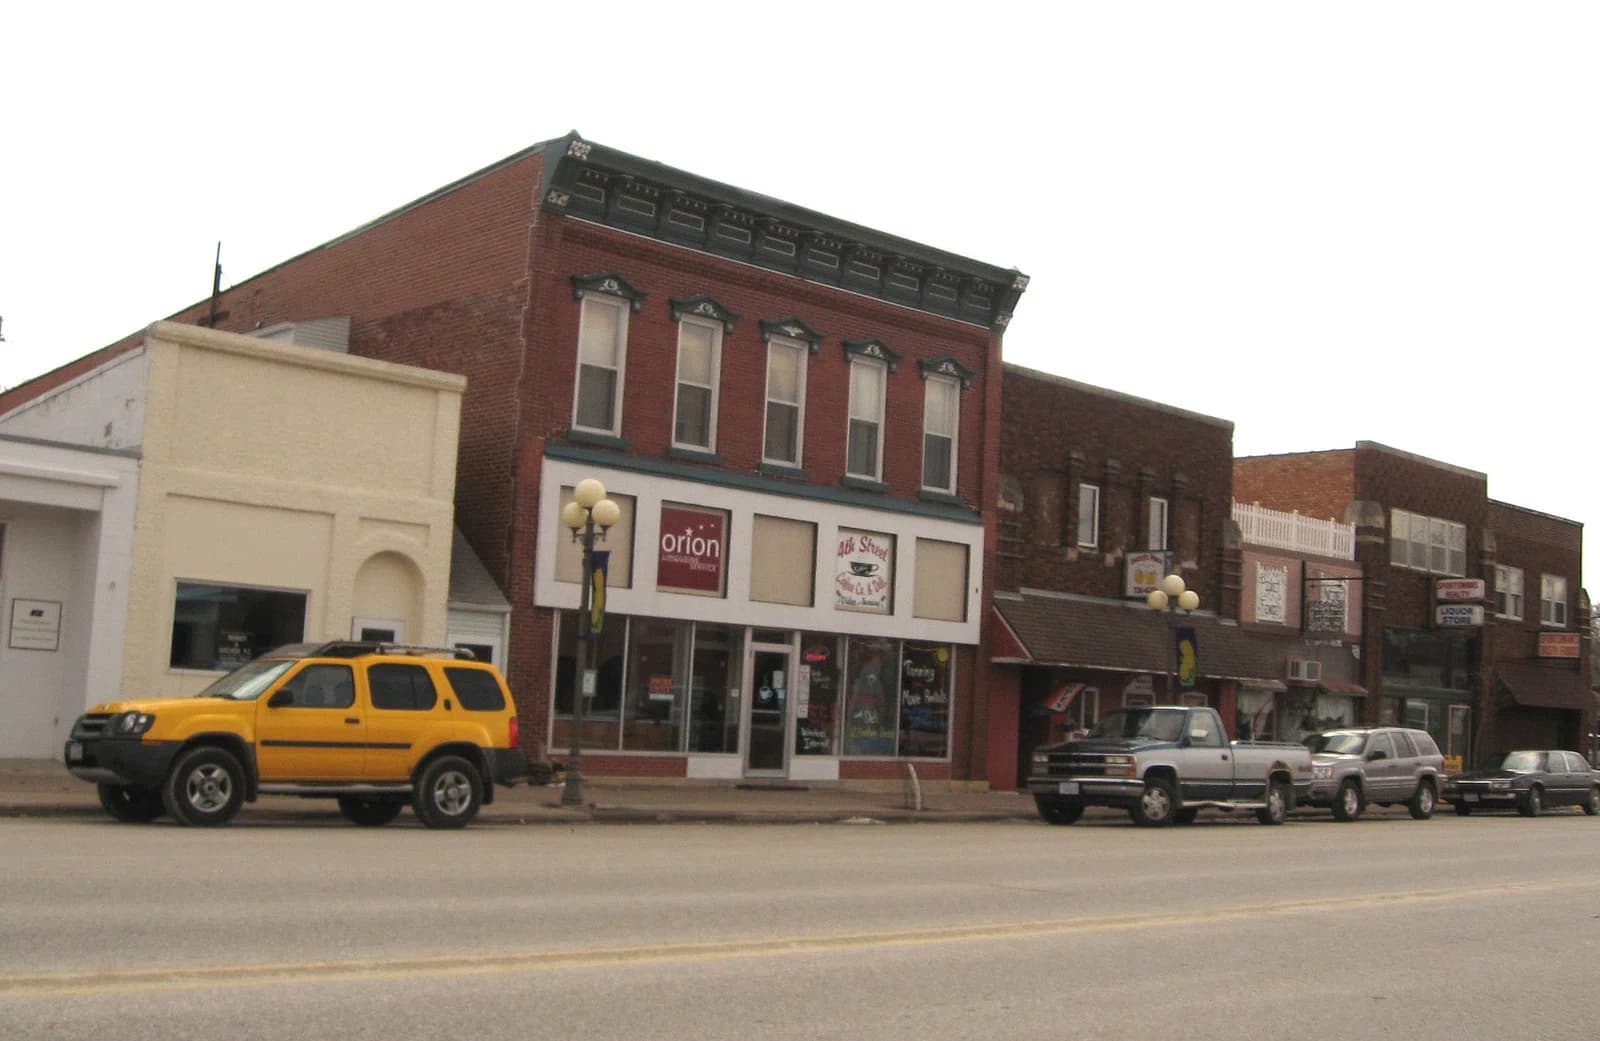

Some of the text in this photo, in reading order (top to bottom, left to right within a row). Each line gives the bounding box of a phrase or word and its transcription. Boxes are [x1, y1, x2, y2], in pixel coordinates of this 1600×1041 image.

[662, 530, 719, 558] orion
[837, 536, 888, 562] 4th Street
[1441, 607, 1473, 616] LIQUOR
[1442, 616, 1472, 624] STORE
[903, 659, 935, 681] Tanning
